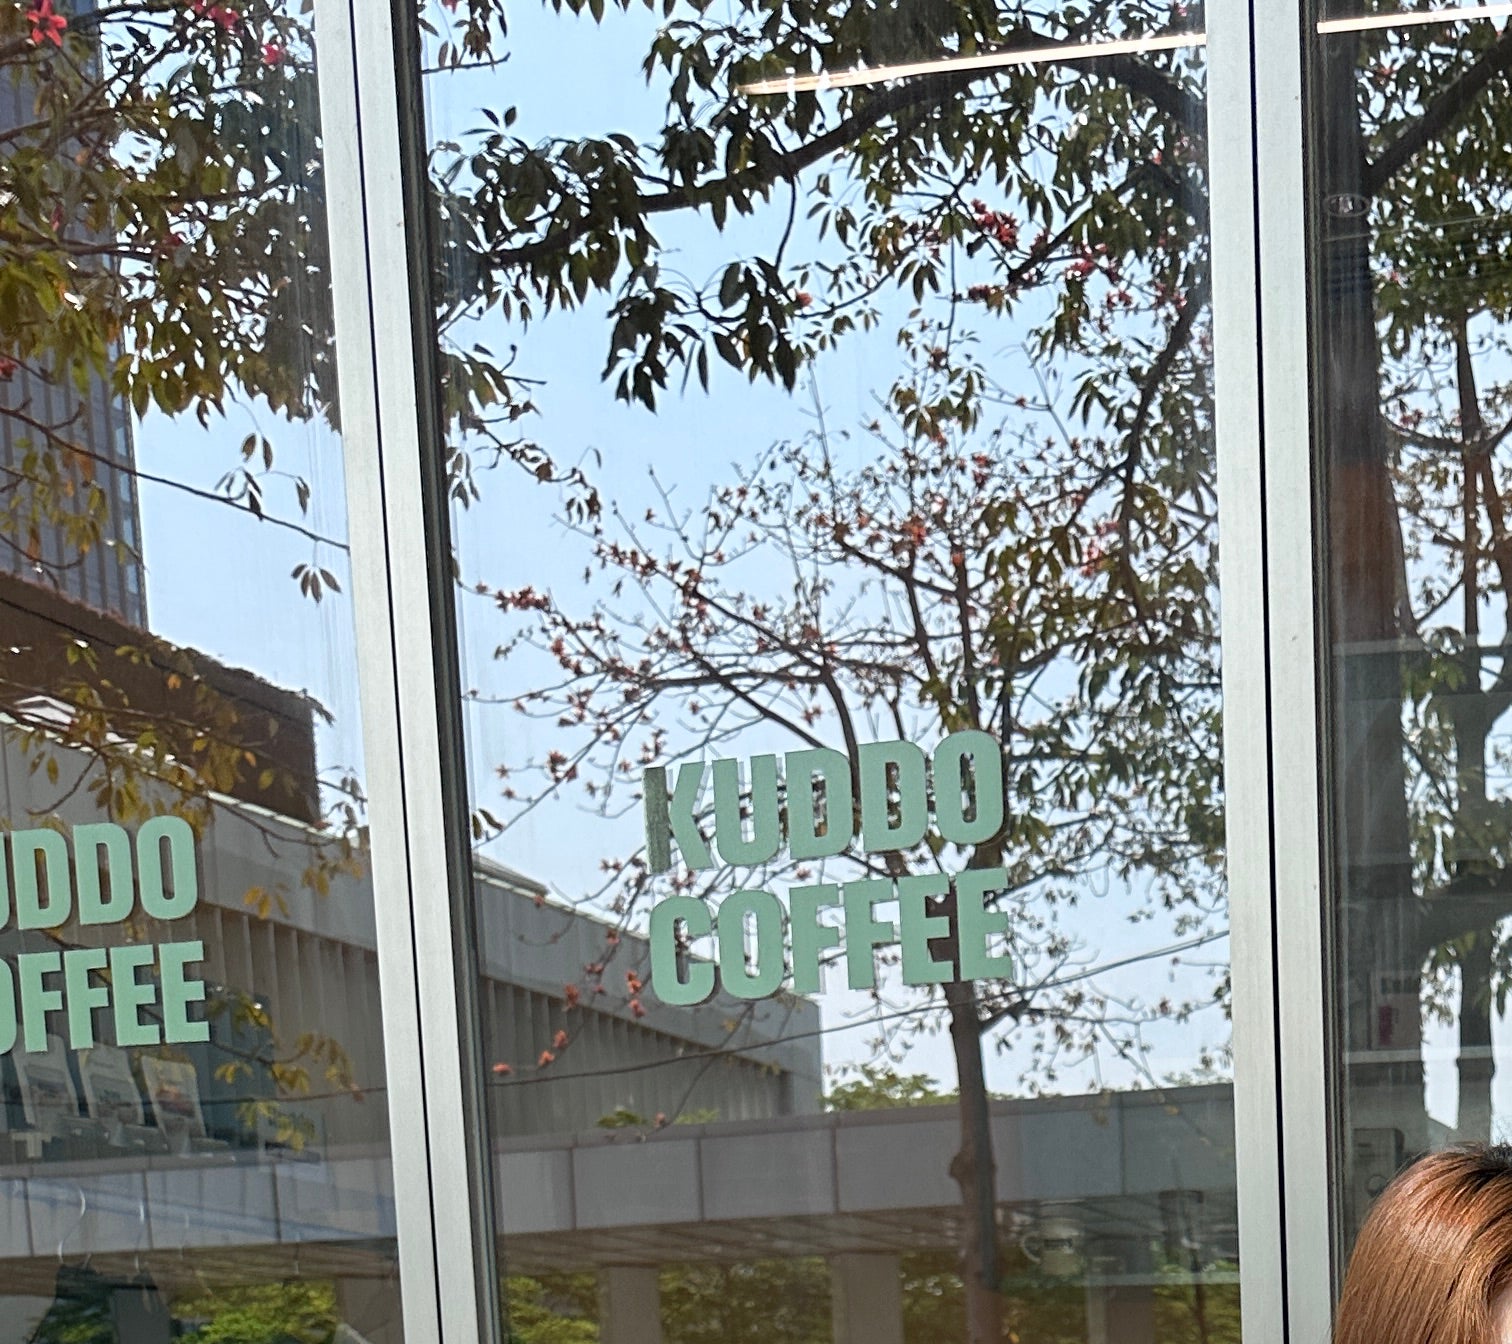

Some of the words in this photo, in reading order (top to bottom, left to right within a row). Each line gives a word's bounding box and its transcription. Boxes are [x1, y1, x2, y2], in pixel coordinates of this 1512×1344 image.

[643, 730, 1002, 873] KUDDO
[0, 815, 198, 930] DDO
[650, 867, 1013, 1005] COFFEE
